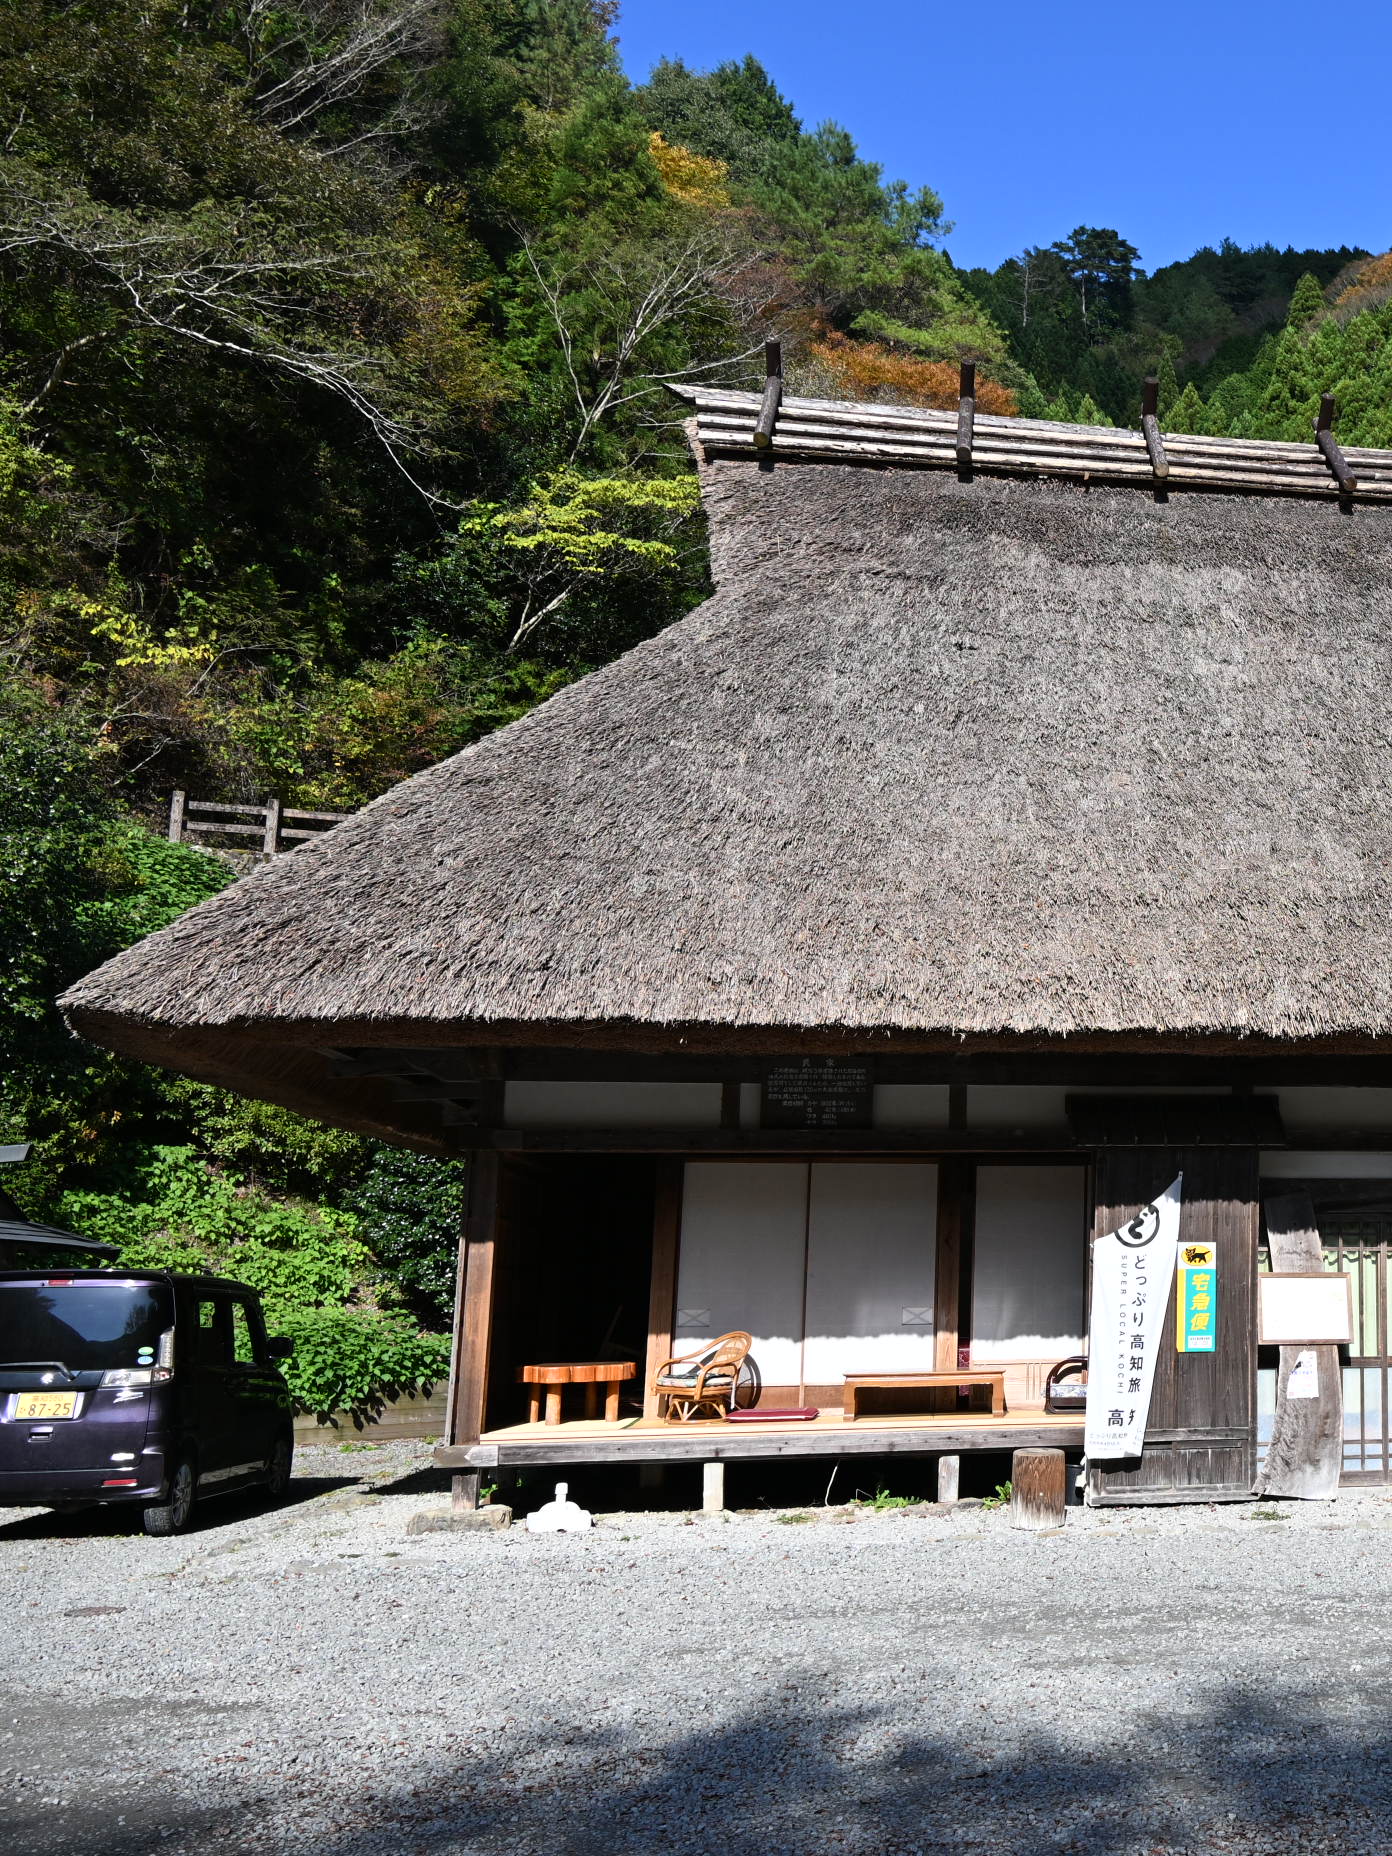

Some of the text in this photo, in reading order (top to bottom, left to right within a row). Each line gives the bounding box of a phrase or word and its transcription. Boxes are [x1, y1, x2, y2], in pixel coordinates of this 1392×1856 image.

[1117, 1255, 1128, 1395] SUPER LOCAL KOCHI
[1127, 1253, 1148, 1394] どっぷり高知旅
[1190, 1272, 1211, 1331] 宅急便
[28, 1403, 71, 1416] 87-25
